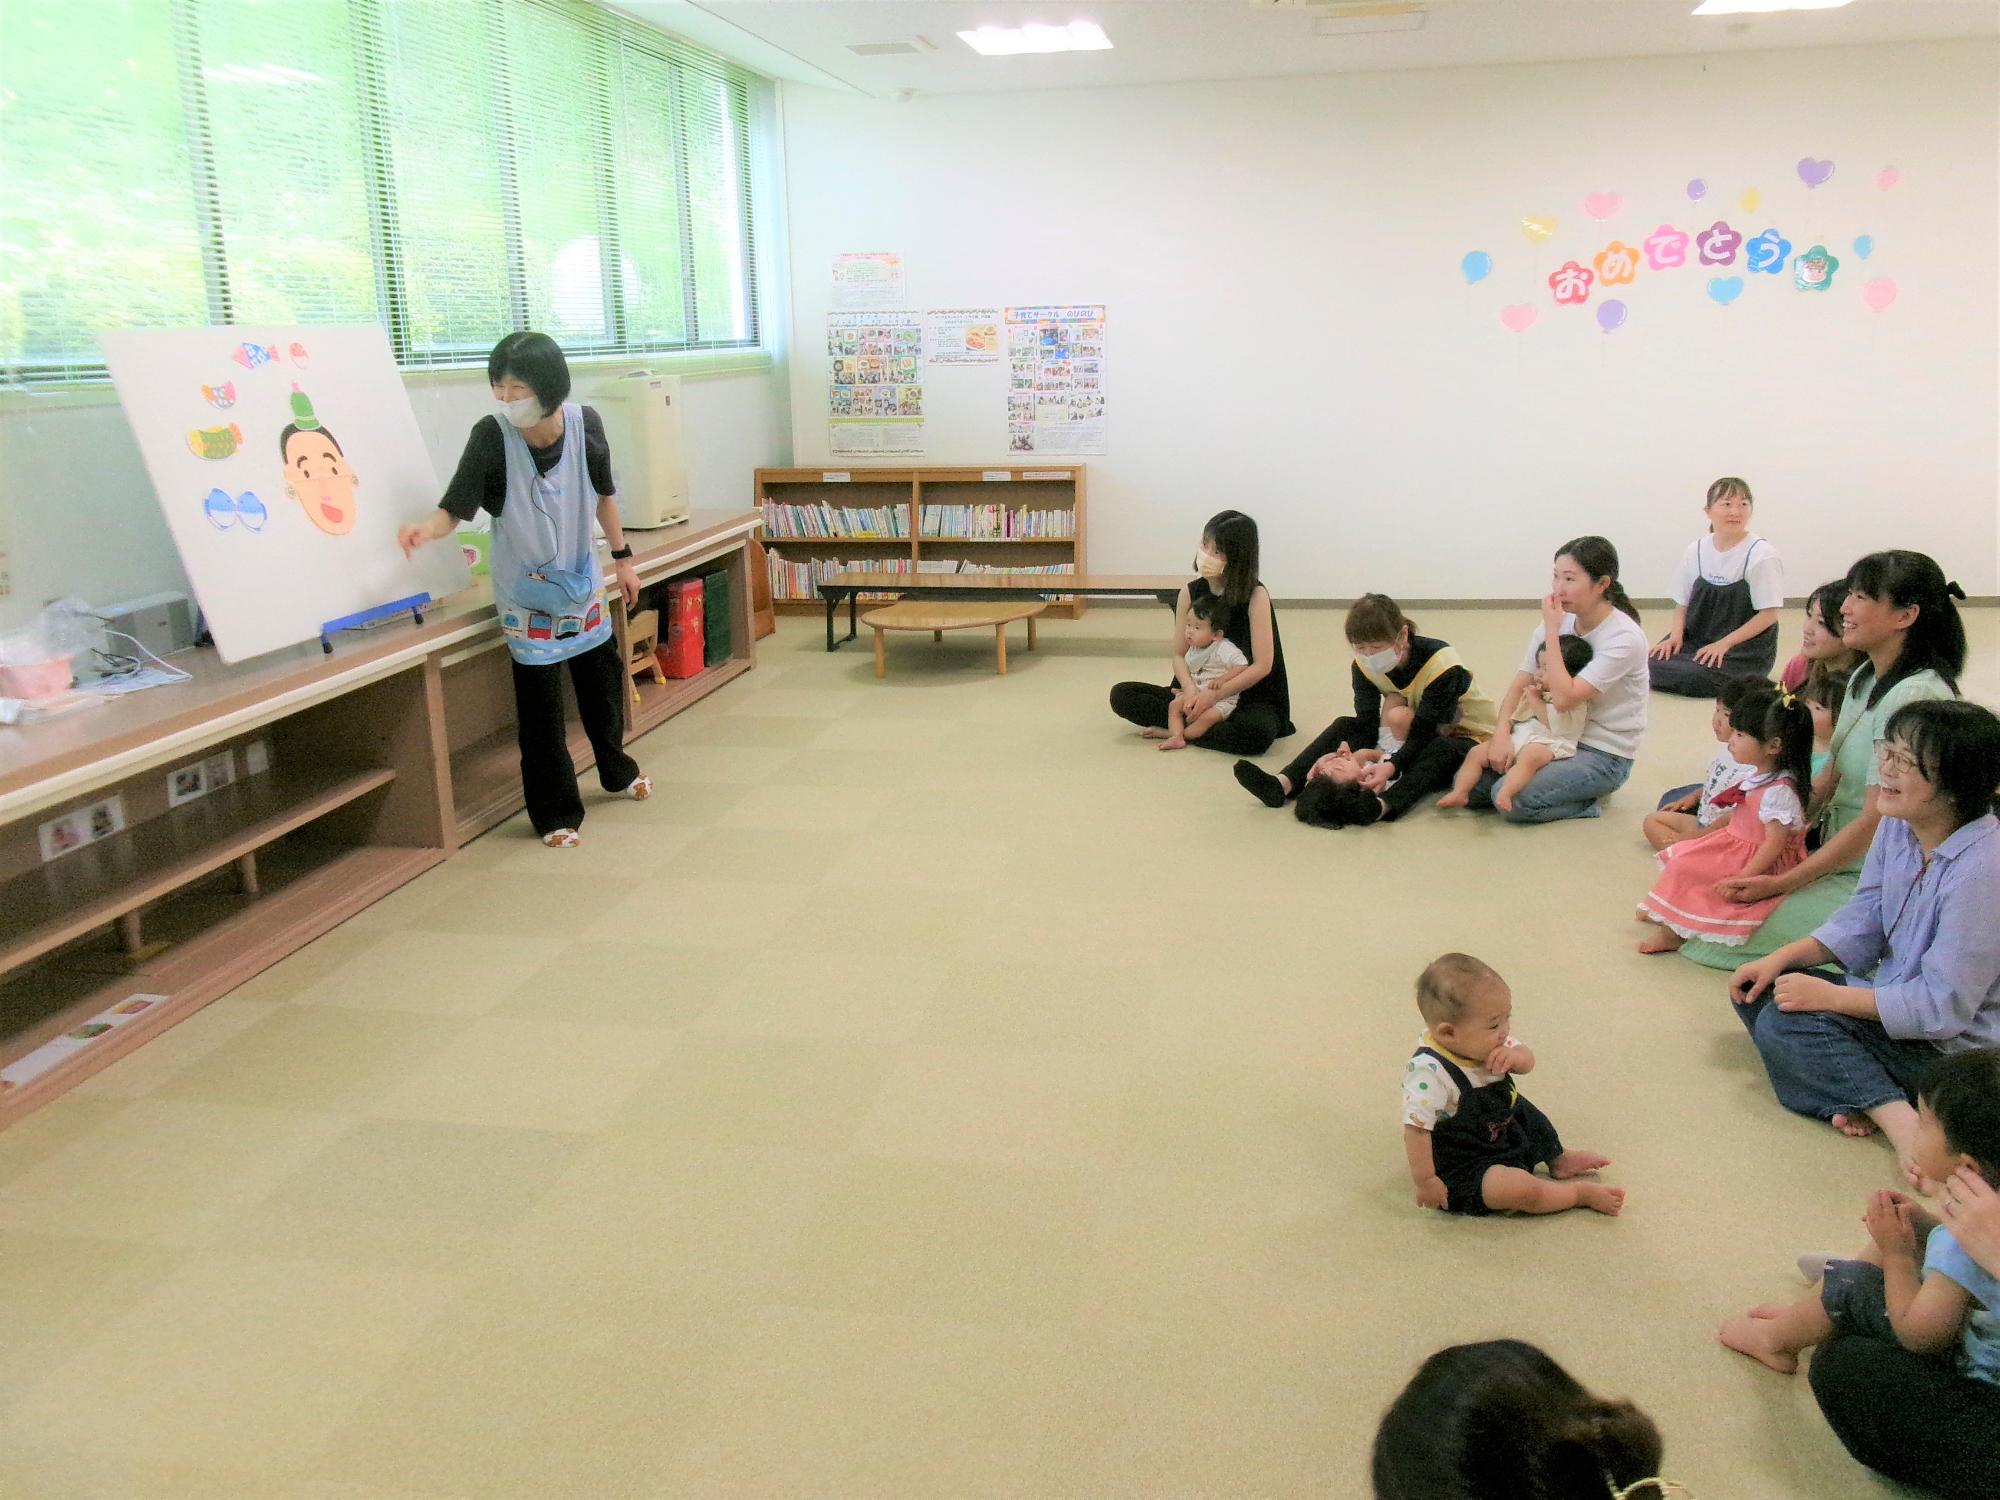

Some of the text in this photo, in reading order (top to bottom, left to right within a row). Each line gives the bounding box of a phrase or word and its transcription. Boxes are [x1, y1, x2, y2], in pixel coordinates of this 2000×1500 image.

[1556, 229, 1781, 299] おめでとう
